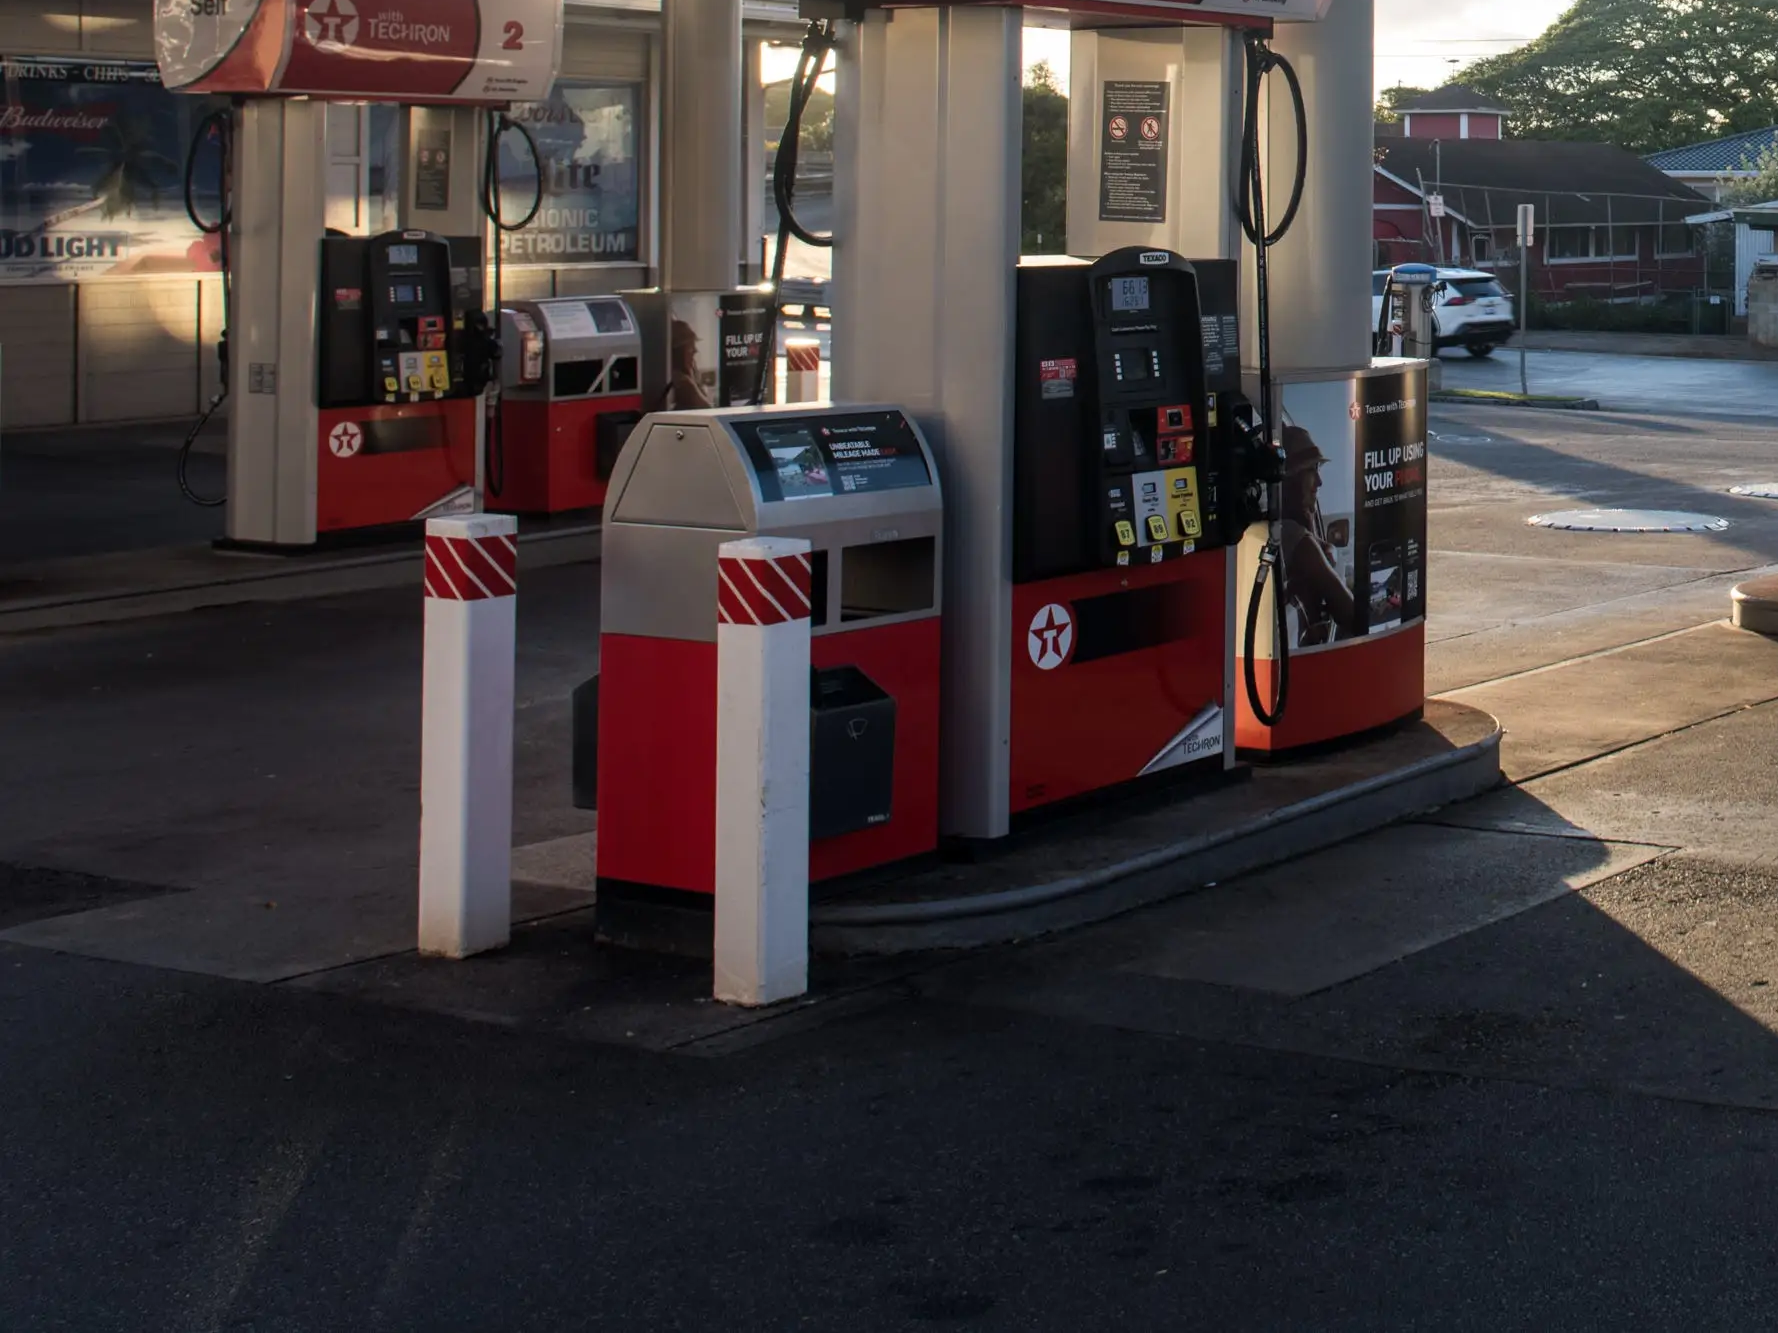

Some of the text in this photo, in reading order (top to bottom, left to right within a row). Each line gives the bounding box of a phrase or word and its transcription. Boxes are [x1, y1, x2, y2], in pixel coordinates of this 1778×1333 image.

[377, 8, 404, 22] with
[368, 18, 451, 45] TECHRON
[502, 20, 524, 50] 2
[8, 65, 68, 80] DRINKS
[83, 66, 129, 81] CHIPS
[0, 105, 110, 129] Budweiser
[525, 208, 598, 229] BIONIC
[40, 236, 120, 257] LIGHT
[500, 232, 626, 255] PETROLEUM
[1142, 254, 1167, 264] TEXACO
[725, 334, 743, 346] FILL
[743, 333, 754, 344] UP
[725, 346, 748, 358] YOUR
[1365, 403, 1386, 415] Texaco
[828, 440, 872, 451] UNBEATABLE
[832, 449, 862, 459] MILEAGE
[861, 447, 881, 457] MADE
[1364, 441, 1424, 469] FILL UP USING
[1364, 470, 1394, 492] YOUR
[1185, 519, 1196, 529] 92
[1120, 529, 1130, 539] 87
[1182, 734, 1221, 755] TECHRON
